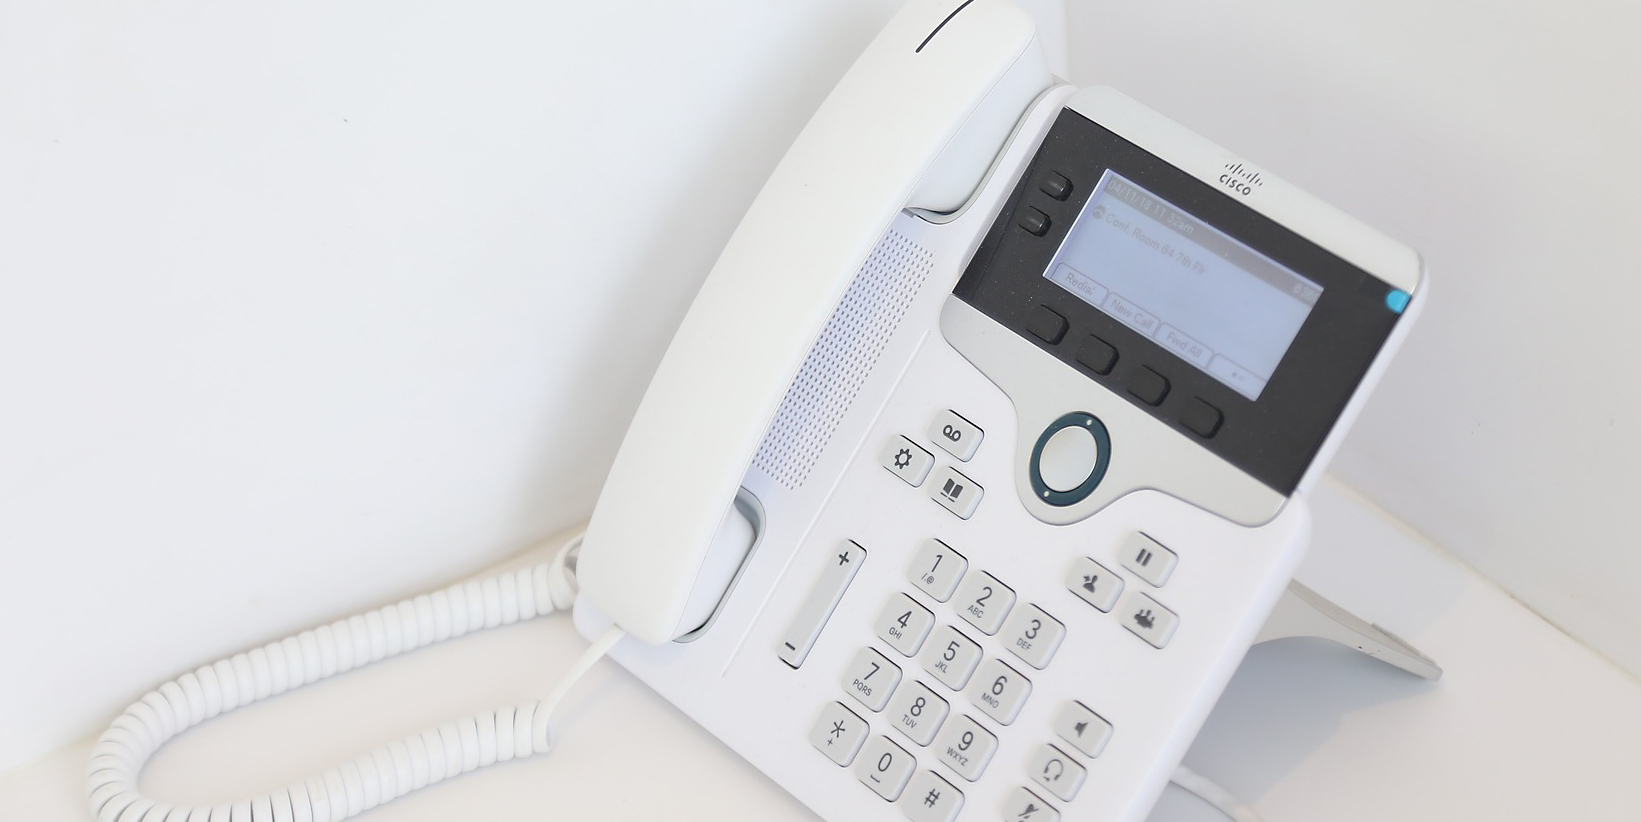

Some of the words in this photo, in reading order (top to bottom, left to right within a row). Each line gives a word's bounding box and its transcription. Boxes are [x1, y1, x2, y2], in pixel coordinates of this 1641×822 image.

[1220, 174, 1251, 195] CISCO
[1131, 227, 1160, 250] Room
[1111, 300, 1132, 317] New
[1133, 313, 1154, 332] Call
[1167, 332, 1188, 350] Fwd
[1189, 345, 1203, 359] All
[932, 555, 942, 572] 1
[976, 587, 992, 607] 2
[898, 611, 912, 628] 4
[968, 605, 983, 618] ABC
[889, 627, 902, 639] GHI
[1026, 619, 1041, 639] 3
[944, 641, 960, 661] 5
[1017, 638, 1031, 649] DEF
[864, 662, 880, 680] 7
[935, 661, 947, 673] JKL
[853, 679, 872, 696] PQRS
[992, 676, 1007, 695] 6
[911, 697, 925, 716] 8
[982, 693, 998, 708] MNO
[903, 715, 917, 728] TUV
[958, 731, 973, 751] 9
[878, 753, 892, 772] 0
[947, 748, 968, 766] WXYZ
[924, 789, 940, 807] #
